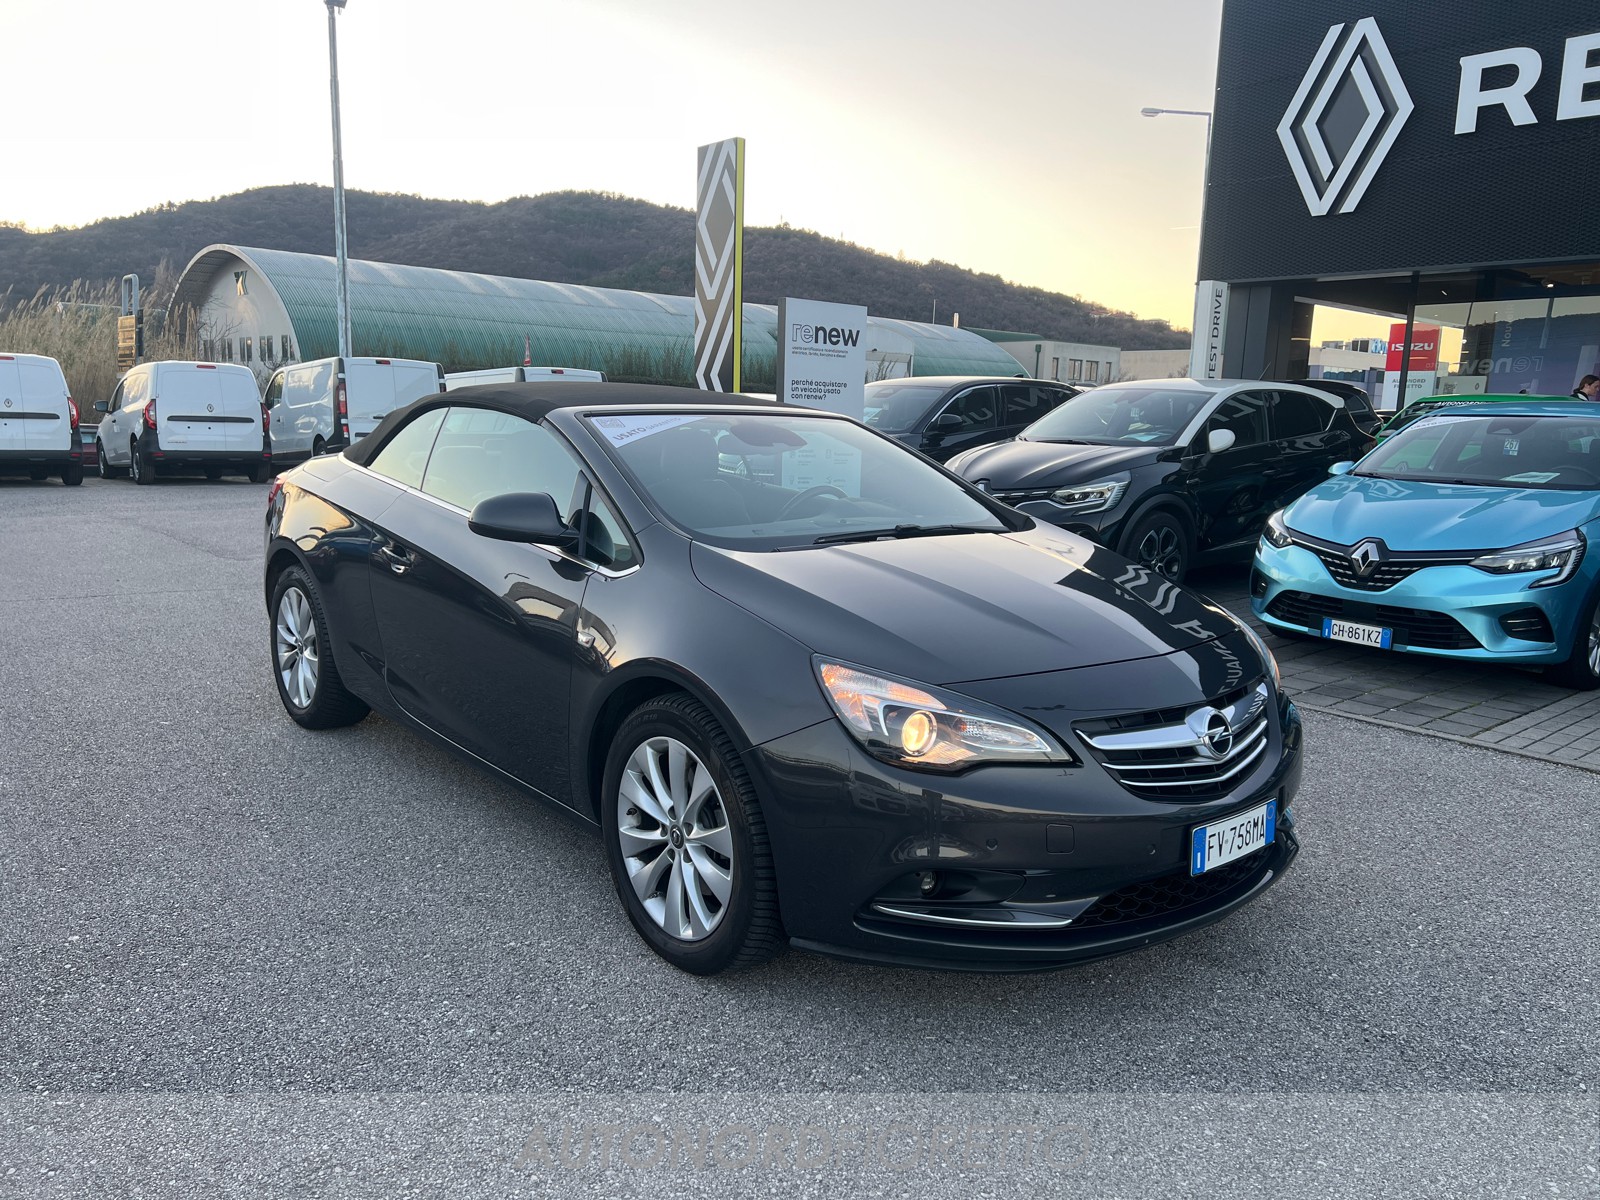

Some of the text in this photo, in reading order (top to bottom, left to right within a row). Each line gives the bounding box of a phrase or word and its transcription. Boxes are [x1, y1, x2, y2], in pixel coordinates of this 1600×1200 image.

[1211, 288, 1223, 338] DRIVE
[791, 323, 860, 347] renew
[791, 379, 813, 387] perché
[800, 386, 823, 394] veicolo
